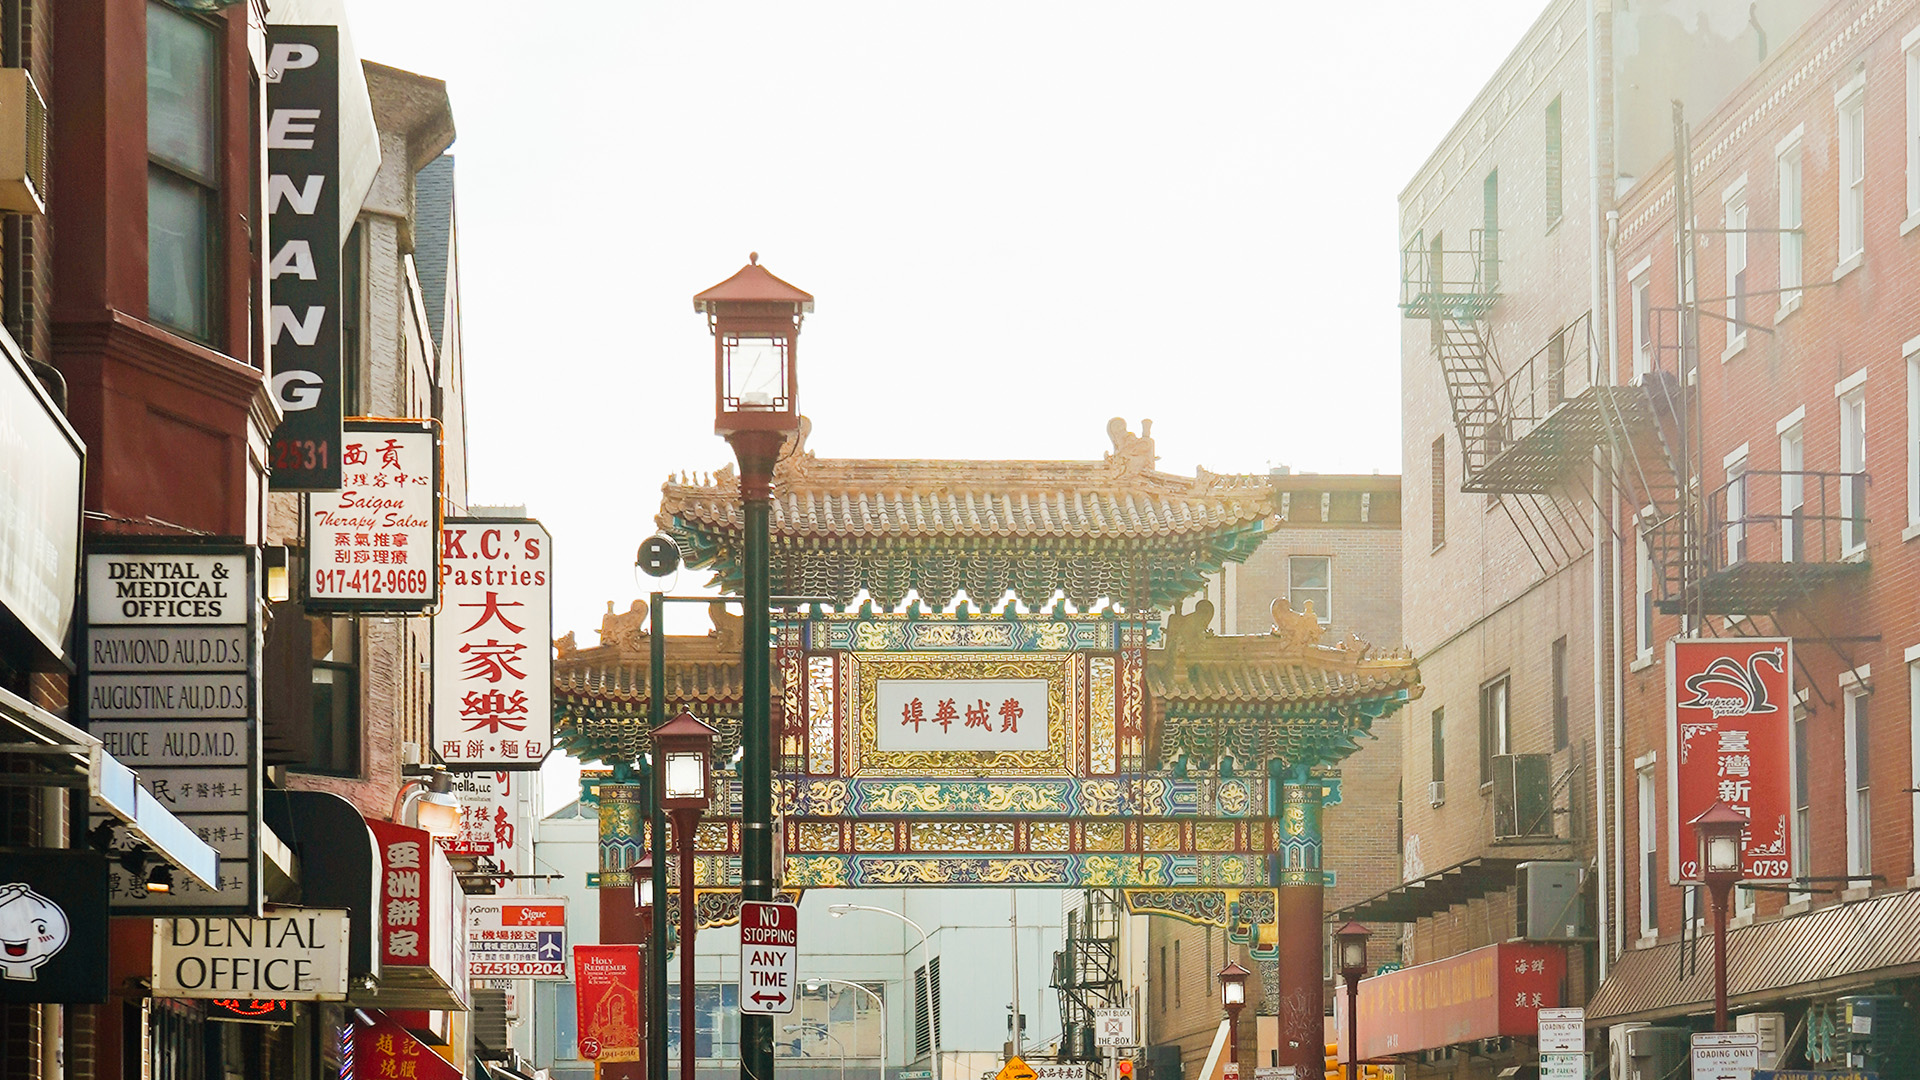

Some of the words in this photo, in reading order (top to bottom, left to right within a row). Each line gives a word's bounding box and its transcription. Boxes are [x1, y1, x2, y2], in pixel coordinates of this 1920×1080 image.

[266, 43, 326, 412] PENANG
[338, 491, 404, 514] Saigon
[314, 511, 376, 530] Therapy
[382, 513, 429, 528] Salon
[443, 529, 540, 560] K.C.'s
[108, 562, 199, 579] DENTAL
[211, 562, 229, 579] &
[438, 564, 545, 586] Pastries
[116, 581, 227, 598] MEDICAL
[316, 569, 427, 594] 917-412-9669
[122, 600, 222, 617] OFFICES
[94, 639, 169, 664] RAYMOND
[458, 591, 529, 734] 大家樂
[90, 686, 174, 709] AUGUSTINE
[104, 732, 149, 757] FELICE
[198, 827, 244, 843] 醫博士
[1741, 860, 1788, 877] -0739
[387, 841, 420, 957] 亞洲餅家
[470, 905, 499, 914] yGram
[520, 907, 547, 920] Sigue
[759, 906, 780, 927] NO
[171, 917, 326, 949] DENTAL
[743, 927, 795, 944] STOPPING
[750, 951, 787, 967] ANY
[176, 957, 313, 991] OFFICE
[750, 971, 788, 987] TIME
[584, 1041, 598, 1053] 75
[1098, 1037, 1111, 1045] THE
[1114, 1037, 1130, 1045] BOX
[1696, 1050, 1731, 1058] LOADING
[1733, 1049, 1754, 1057] ONLY
